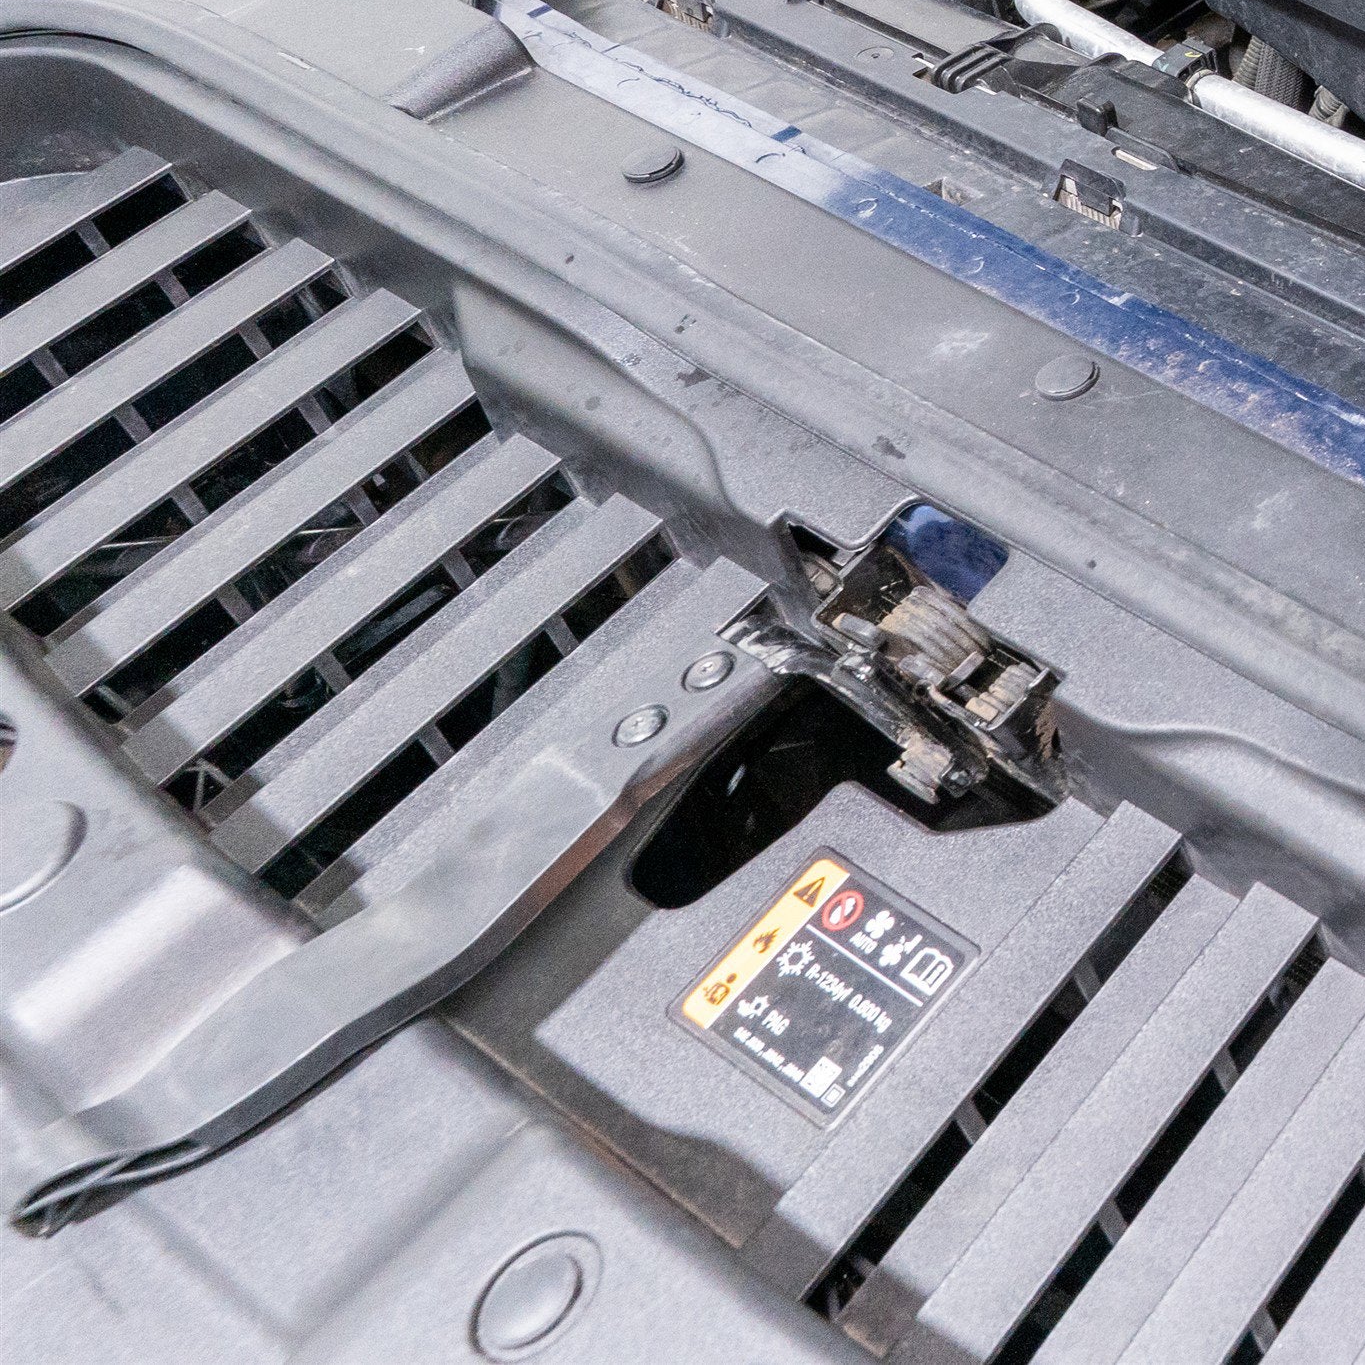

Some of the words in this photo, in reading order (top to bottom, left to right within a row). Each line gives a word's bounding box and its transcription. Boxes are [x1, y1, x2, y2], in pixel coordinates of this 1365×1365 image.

[849, 931, 879, 955] AUTO
[804, 962, 854, 1001] R-1234yf
[877, 1012, 893, 1034] kg
[763, 1009, 791, 1036] PAG
